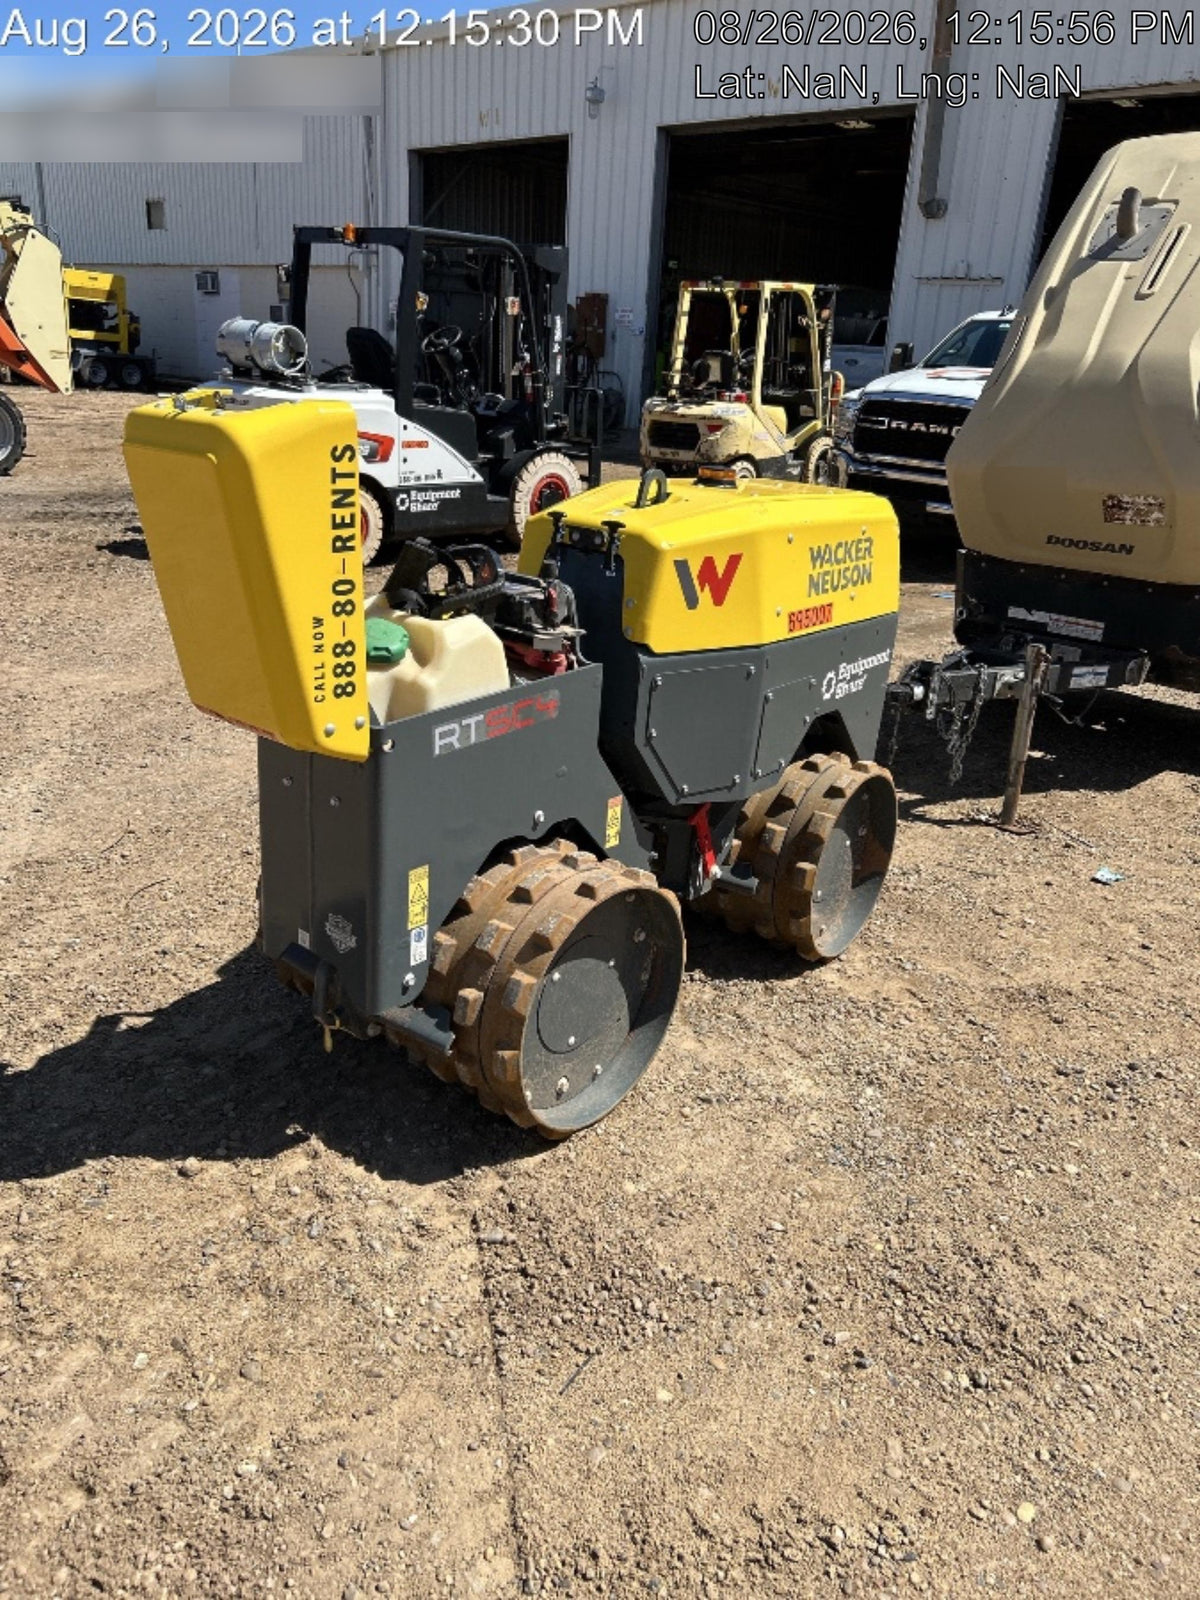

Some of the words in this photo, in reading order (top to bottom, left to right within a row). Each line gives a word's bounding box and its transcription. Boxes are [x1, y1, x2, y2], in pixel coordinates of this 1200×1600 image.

[890, 420, 949, 434] RAM
[410, 488, 461, 502] Equipment
[808, 537, 874, 570] WACKER
[1045, 534, 1135, 556] DOOSAN
[330, 443, 356, 699] 888-80-RENTS
[807, 561, 872, 598] NEUSON
[312, 616, 325, 653] NOW
[837, 648, 890, 680] Equipment
[313, 661, 326, 703] CALL
